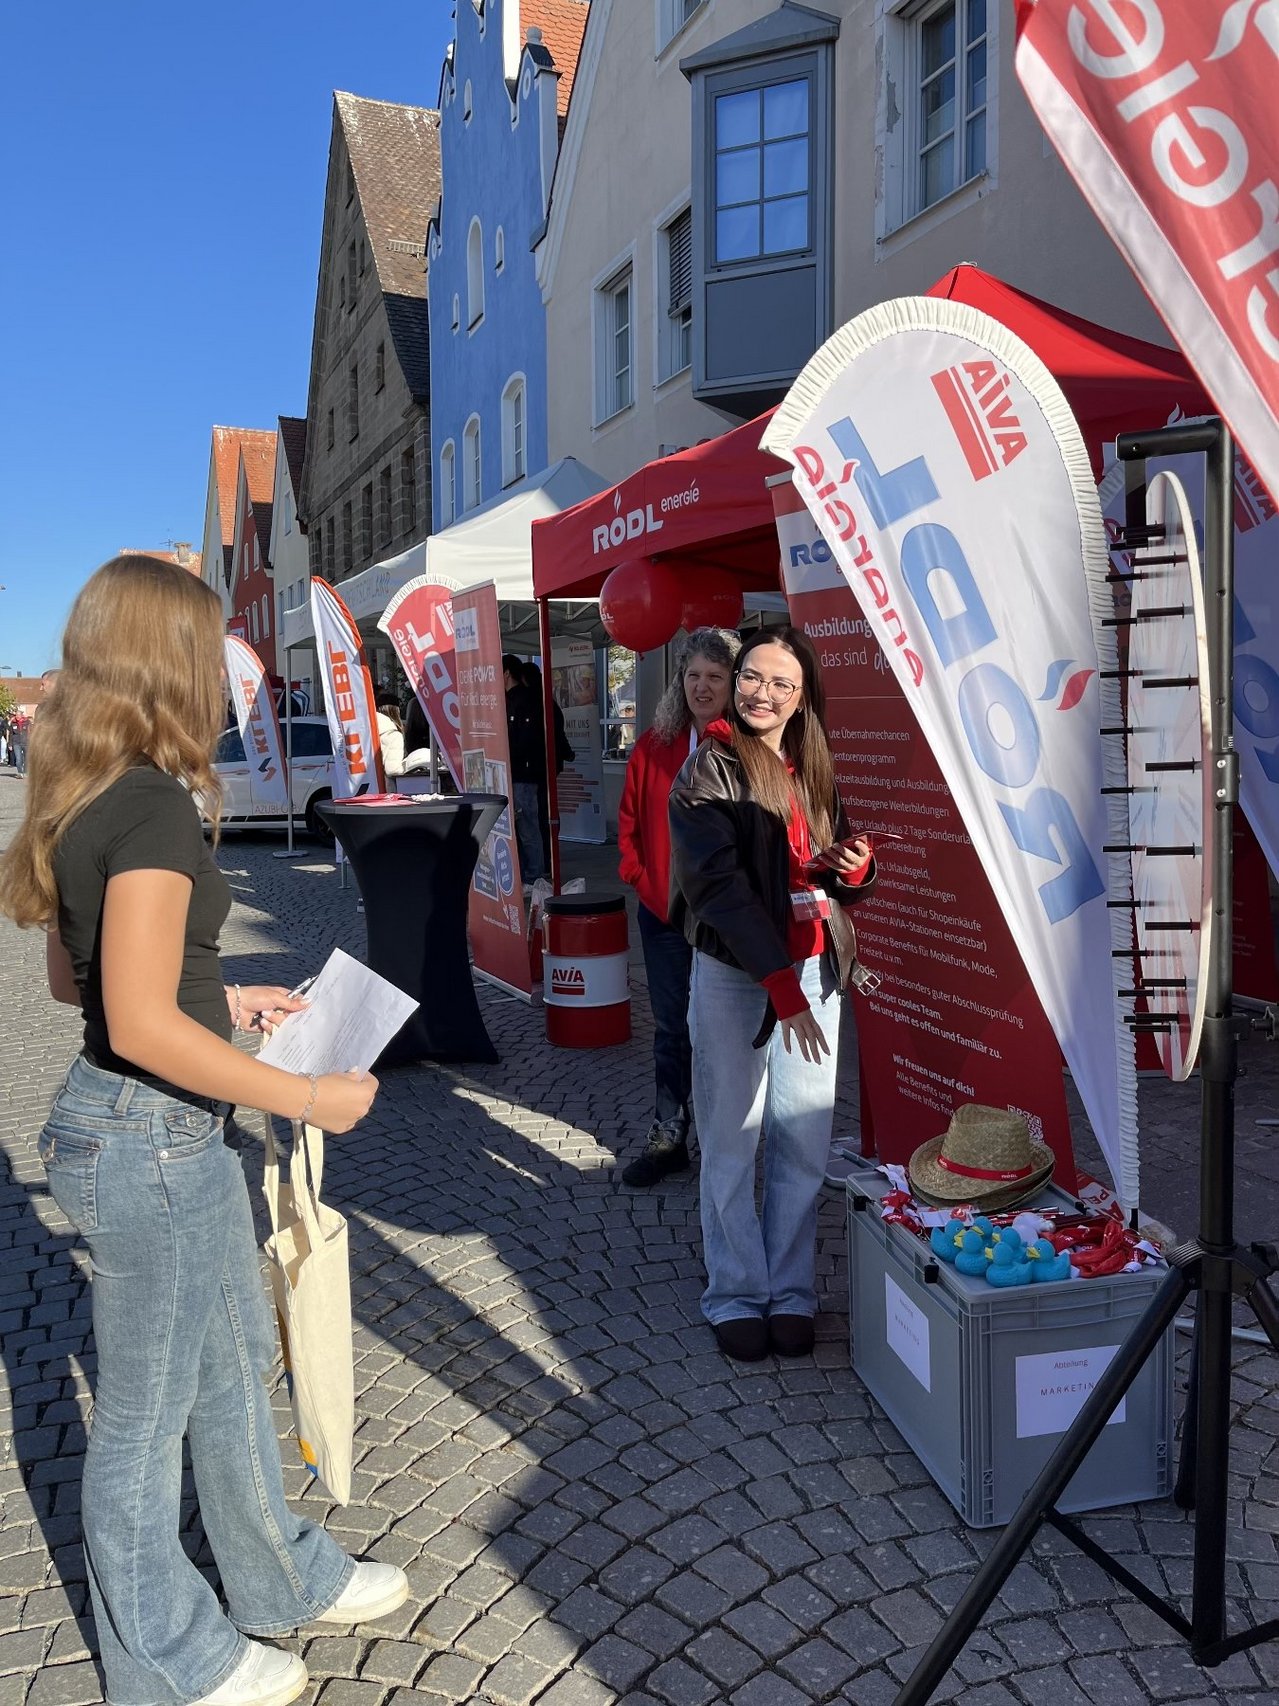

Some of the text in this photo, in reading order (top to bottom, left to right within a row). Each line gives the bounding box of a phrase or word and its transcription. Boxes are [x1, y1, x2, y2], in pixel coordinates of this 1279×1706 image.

[804, 617, 873, 639] Ausbildung
[820, 649, 841, 667] das
[843, 645, 868, 666] sind
[828, 729, 840, 739] ute
[833, 752, 896, 765] entorenprogramm
[834, 774, 891, 790] eilzeitausbildung
[891, 779, 906, 788] und
[840, 796, 950, 818] erufsbezogene Weiterbildungen
[847, 817, 971, 845] Tage Urlaub plus 2 Tage Sonderurla
[915, 884, 957, 903] Leistungen
[853, 909, 862, 917] an
[862, 911, 889, 924] unseren
[917, 906, 929, 918] für
[929, 909, 982, 932] Shopeinkäufe
[856, 928, 889, 946] Corporate
[888, 937, 918, 954] Benefits
[895, 974, 931, 995] besonders
[931, 988, 951, 1001] guter
[952, 994, 1024, 1029] Abschlussprüfung
[897, 998, 921, 1013] cooles
[920, 1002, 944, 1021] Team.
[869, 1001, 1003, 1060] Bei uns geht es offen und familiär zu.
[892, 1053, 976, 1097] Wir freuen uns auf dich!
[897, 1085, 922, 1102] weitere
[909, 1076, 938, 1097] Benefits
[938, 1090, 953, 1104] und
[1040, 1382, 1096, 1396] MARKETIN
